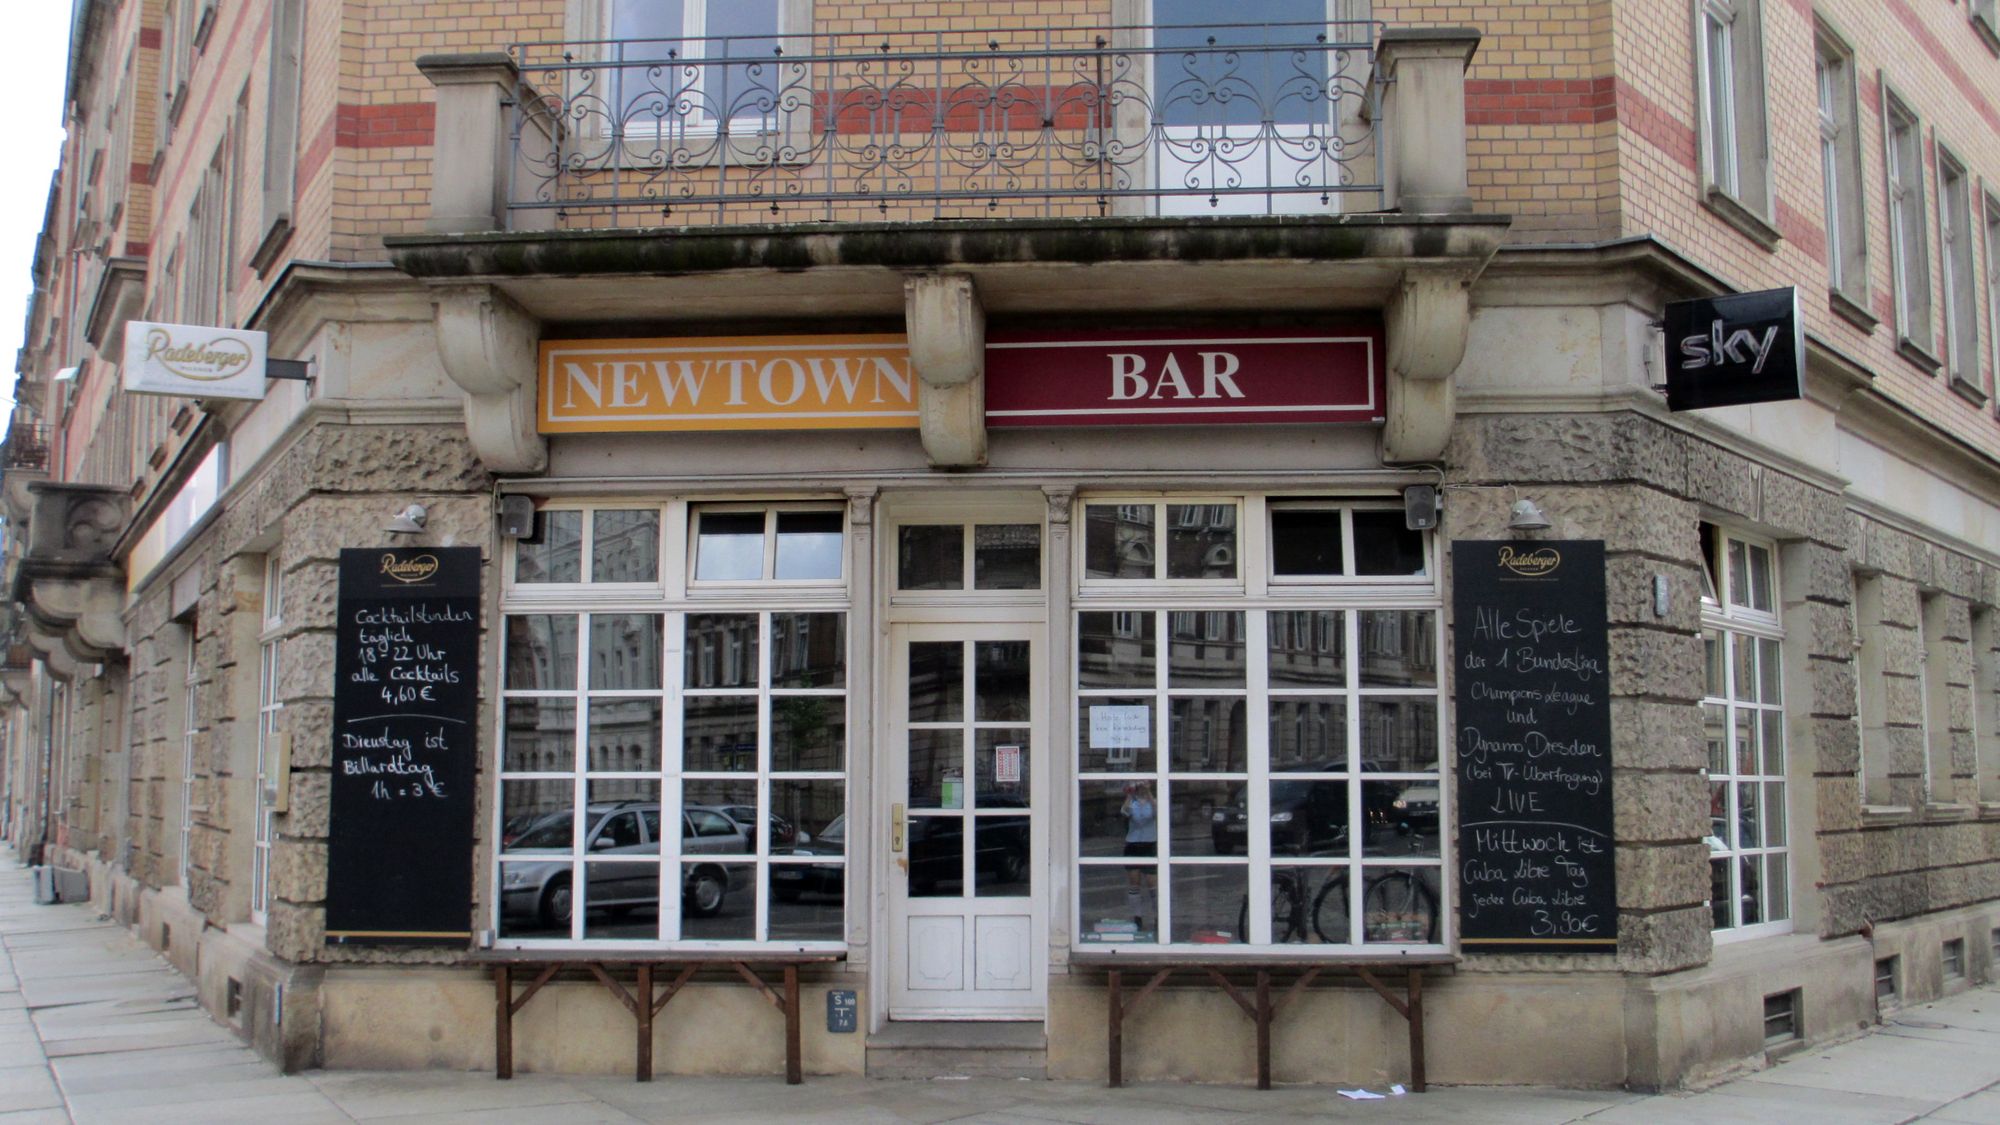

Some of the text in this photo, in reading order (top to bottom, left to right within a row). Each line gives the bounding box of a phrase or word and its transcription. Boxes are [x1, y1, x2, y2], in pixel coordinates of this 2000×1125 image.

[143, 328, 253, 382] Radeberger
[1680, 319, 1778, 374] sky
[561, 357, 912, 409] NEWTOWN
[1107, 351, 1245, 400] BAR
[380, 553, 438, 582] Radeberger
[1498, 546, 1560, 576] Radeberger
[355, 603, 473, 625] Cocktailstunden
[1473, 605, 1582, 644] Alle Spiele
[358, 648, 376, 664] 18
[393, 646, 413, 661] 22
[416, 644, 446, 661] Uhr
[1464, 652, 1486, 669] der
[1516, 646, 1603, 682] Bundesliga
[351, 663, 460, 684] alle Cocktails
[1506, 708, 1538, 725] und
[424, 727, 448, 750] ist
[1459, 727, 1603, 764] Dynamo Dresden
[343, 755, 434, 787] Billardtag
[412, 782, 423, 797] 3
[1490, 786, 1545, 814] LIVE
[1476, 829, 1603, 854] Mittwoch ist
[1463, 855, 1589, 888] Cuba Libre Tag
[1512, 887, 1548, 906] Cuba
[1551, 887, 1587, 905] Libre
